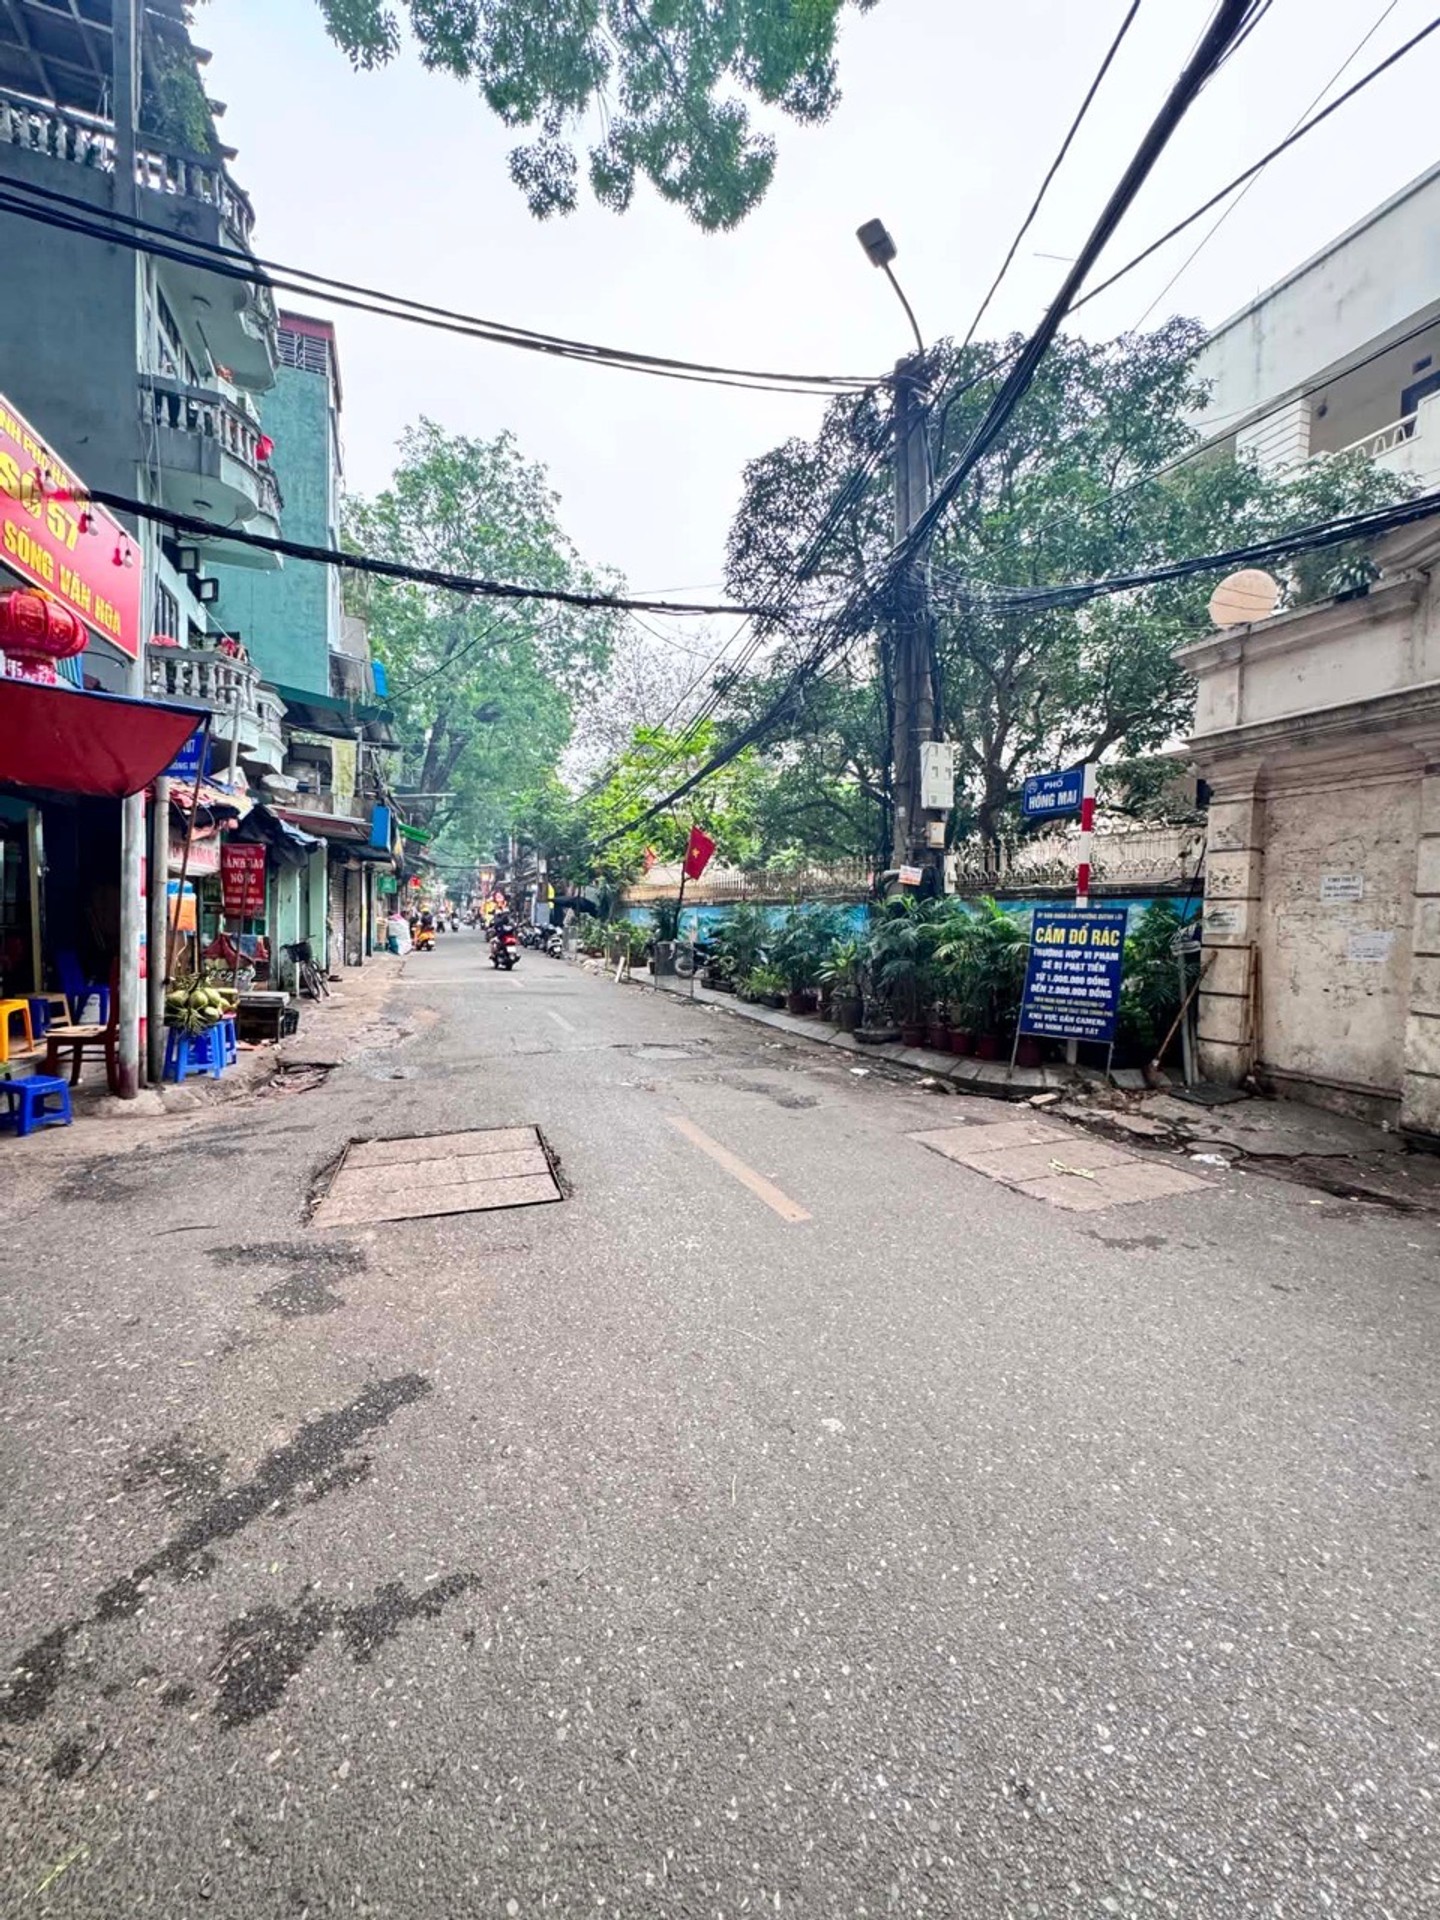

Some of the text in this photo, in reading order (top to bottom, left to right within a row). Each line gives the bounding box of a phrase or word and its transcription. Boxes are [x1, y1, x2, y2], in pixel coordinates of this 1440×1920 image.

[46, 499, 79, 551] 57
[4, 519, 54, 584] SỐNG
[59, 564, 91, 612] VĂN
[1044, 776, 1064, 790] PHỐ
[1057, 789, 1077, 806] MAI
[1035, 922, 1120, 947] CẤM ĐỔ RÁC
[1033, 947, 1119, 962] TRƯỜNG HỢP VI PHẠM
[1053, 961, 1063, 971] BỊ
[1064, 962, 1085, 973] PHẠT
[1030, 983, 1046, 993] ĐẾN
[1075, 1016, 1106, 1027] CAMERA
